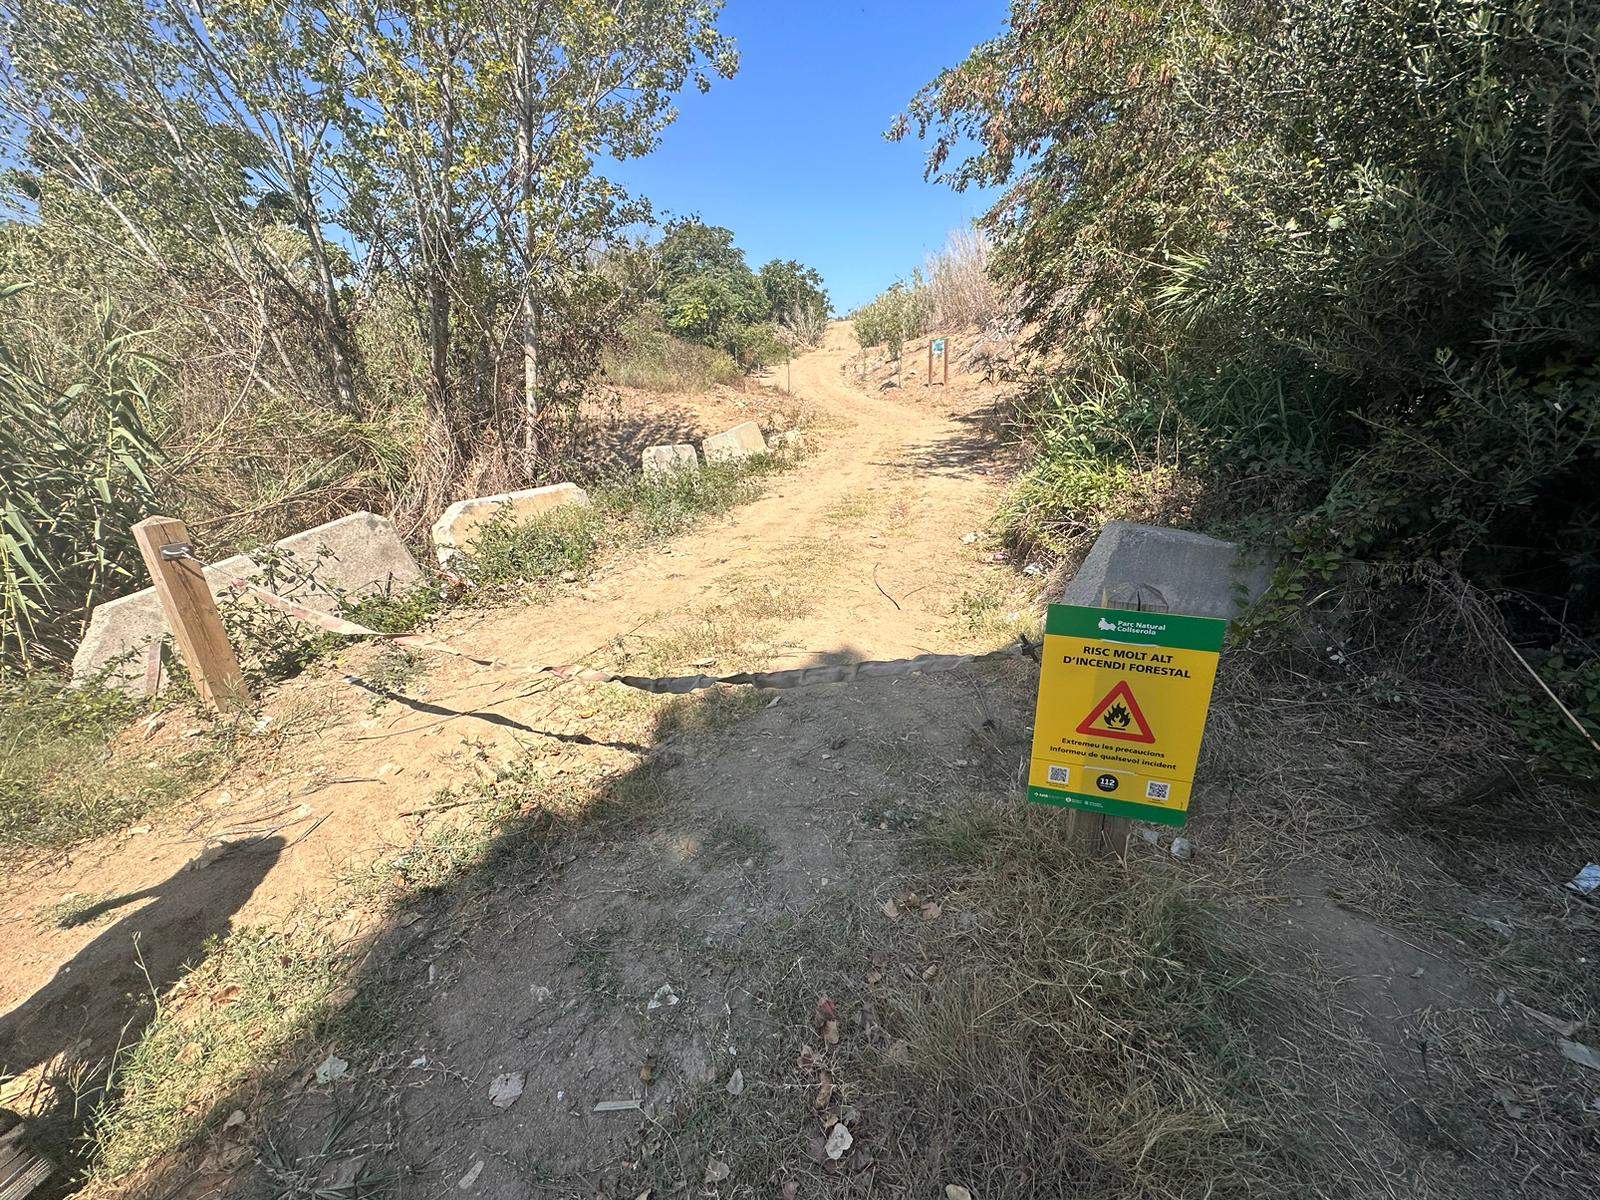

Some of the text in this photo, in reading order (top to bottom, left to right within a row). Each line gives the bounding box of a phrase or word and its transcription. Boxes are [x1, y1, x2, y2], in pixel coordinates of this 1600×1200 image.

[1117, 620, 1166, 631] Parc Natural
[1083, 646, 1173, 664] RISC MOLT ALT
[1063, 656, 1191, 678] D'INCENDI FORESTAL
[1050, 745, 1086, 756] Informeu
[1088, 749, 1098, 758] de
[1142, 758, 1176, 770] incident
[1061, 737, 1165, 759] Extremeu les precaucions
[1100, 778, 1116, 786] 112
